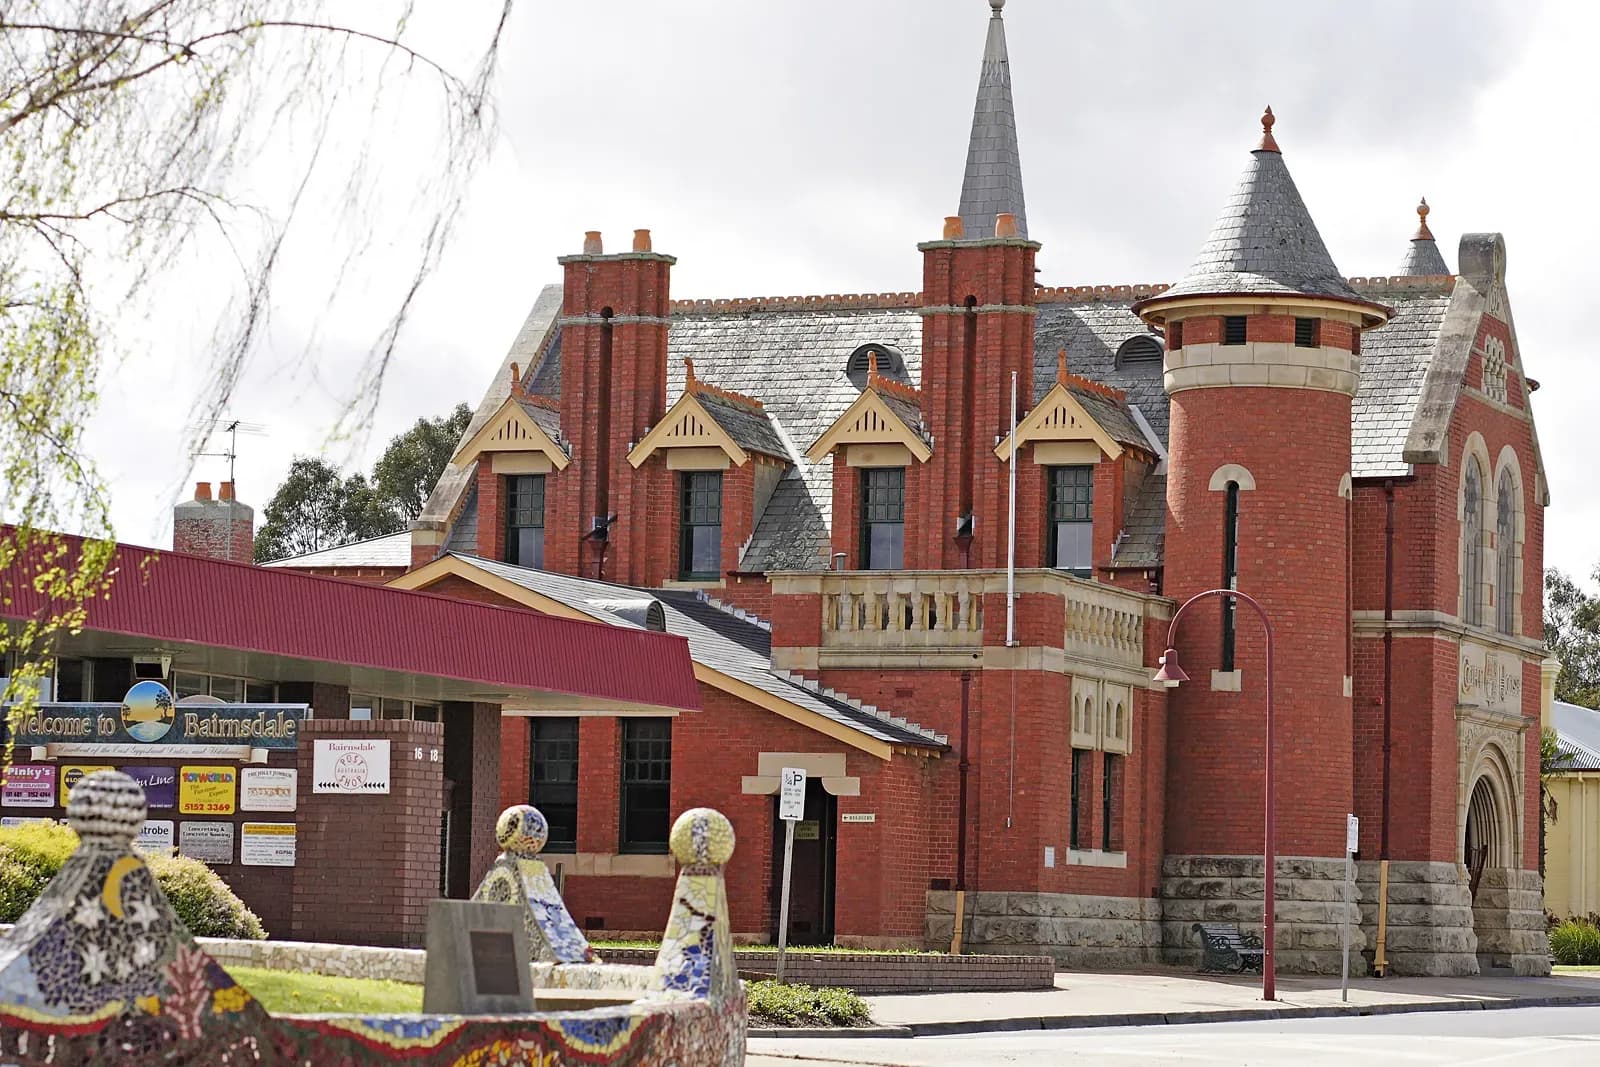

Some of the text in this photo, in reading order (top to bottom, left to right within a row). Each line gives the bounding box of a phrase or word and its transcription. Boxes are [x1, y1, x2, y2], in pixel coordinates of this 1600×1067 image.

[97, 713, 116, 736] to
[184, 711, 297, 738] Bairnsdale
[329, 743, 376, 751] Bairnsdale
[340, 754, 364, 766] POST
[414, 747, 438, 762] 16 18
[8, 767, 51, 779] Pinky's
[182, 772, 233, 783] TOYWORLD
[339, 775, 362, 787] SHOP
[184, 802, 230, 811] 5152 3369
[141, 826, 169, 835] trobe
